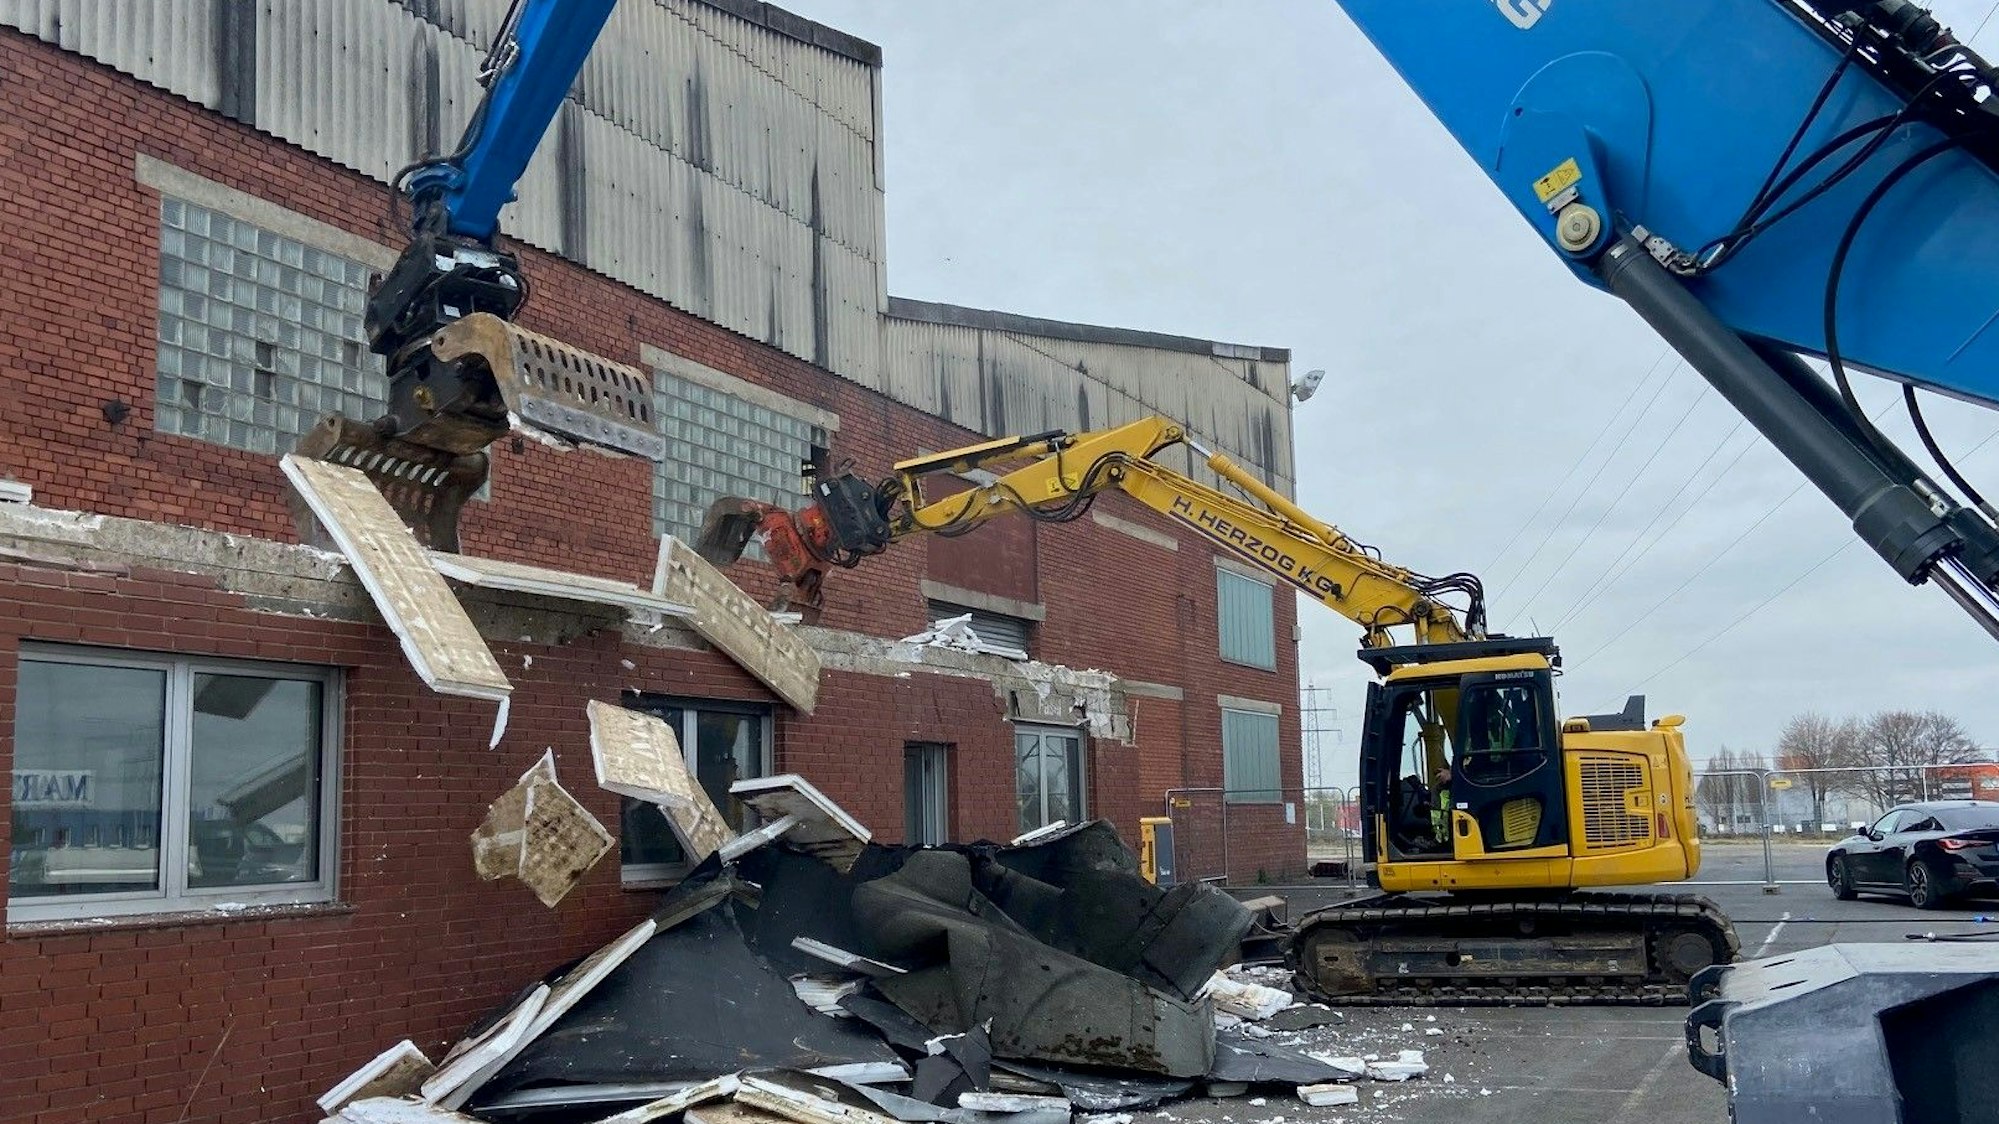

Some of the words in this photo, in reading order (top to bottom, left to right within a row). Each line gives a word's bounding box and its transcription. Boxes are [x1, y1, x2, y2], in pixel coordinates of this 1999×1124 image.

[1172, 495, 1193, 516] H.
[1198, 510, 1296, 572] HERZOG
[1494, 671, 1534, 680] KOMATSU
